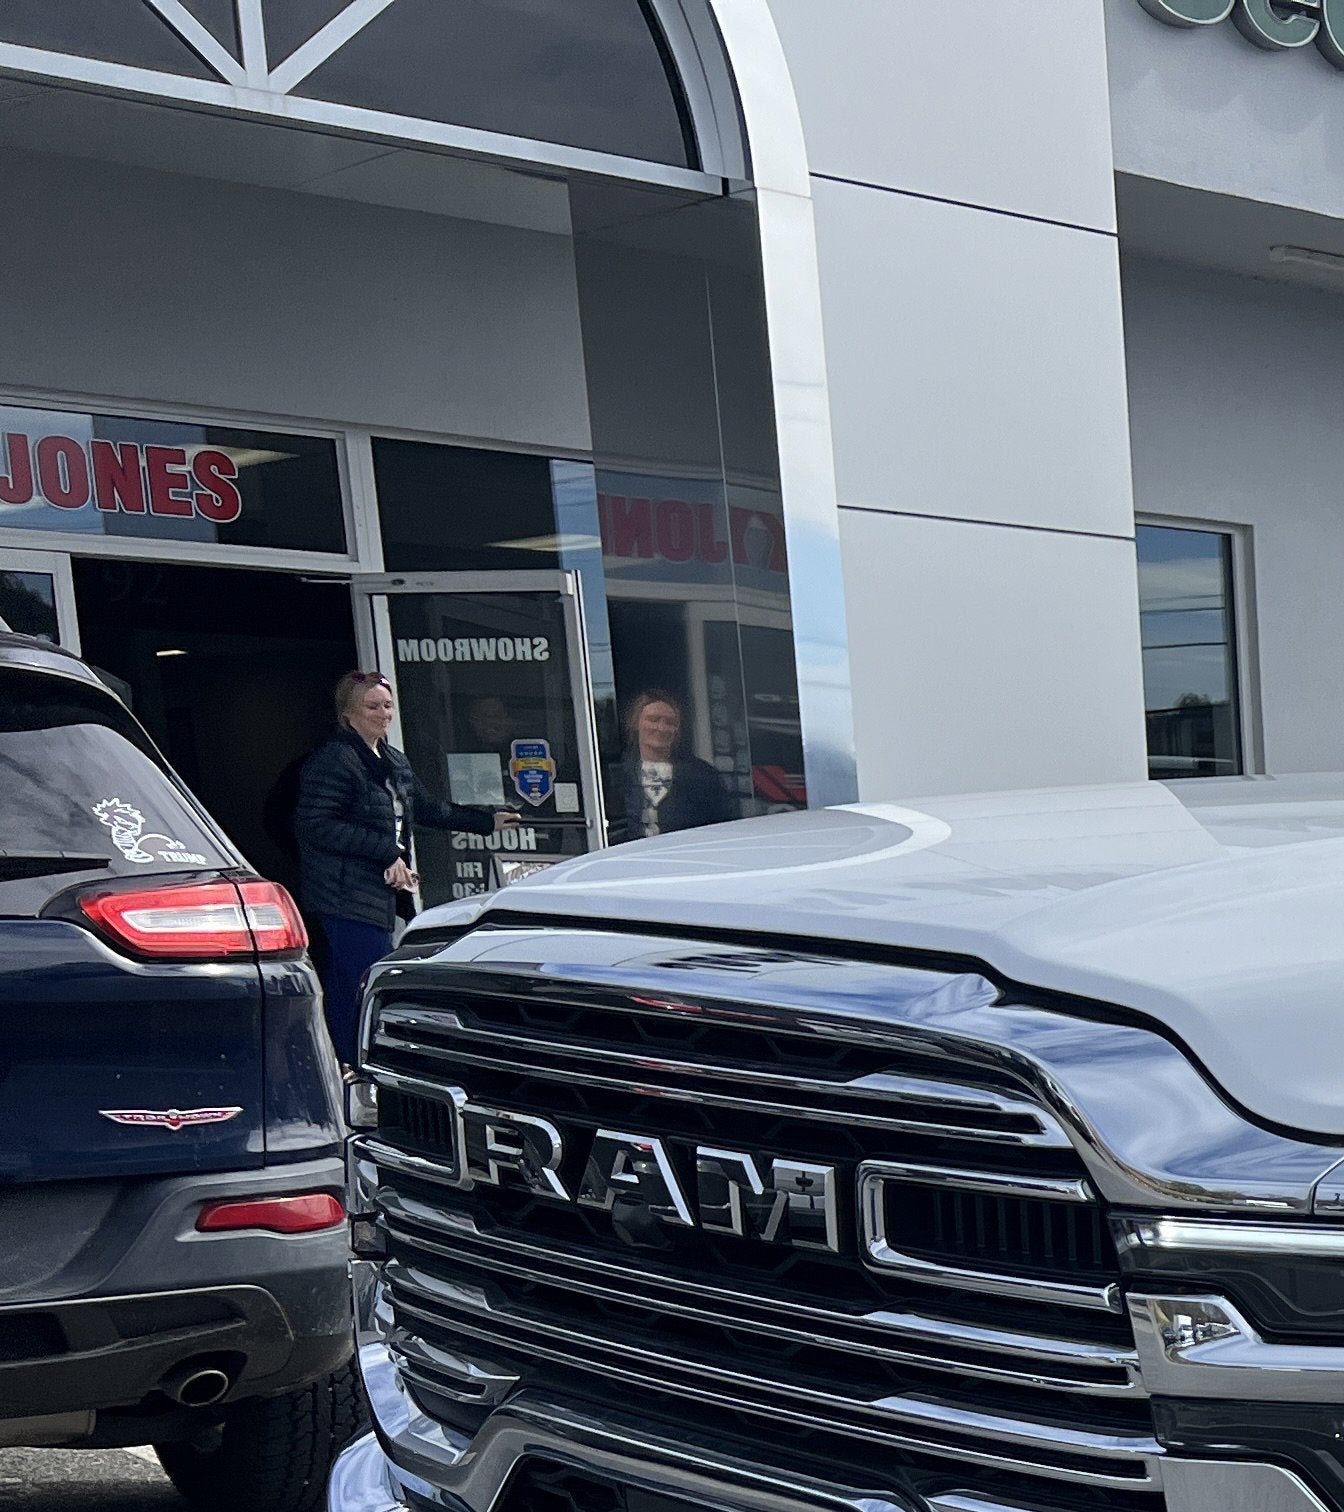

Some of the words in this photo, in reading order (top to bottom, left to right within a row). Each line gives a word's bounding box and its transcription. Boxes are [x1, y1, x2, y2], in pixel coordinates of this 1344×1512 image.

[0, 431, 242, 524] JONES
[158, 850, 208, 866] TRUMP
[462, 1102, 840, 1254] RAM
